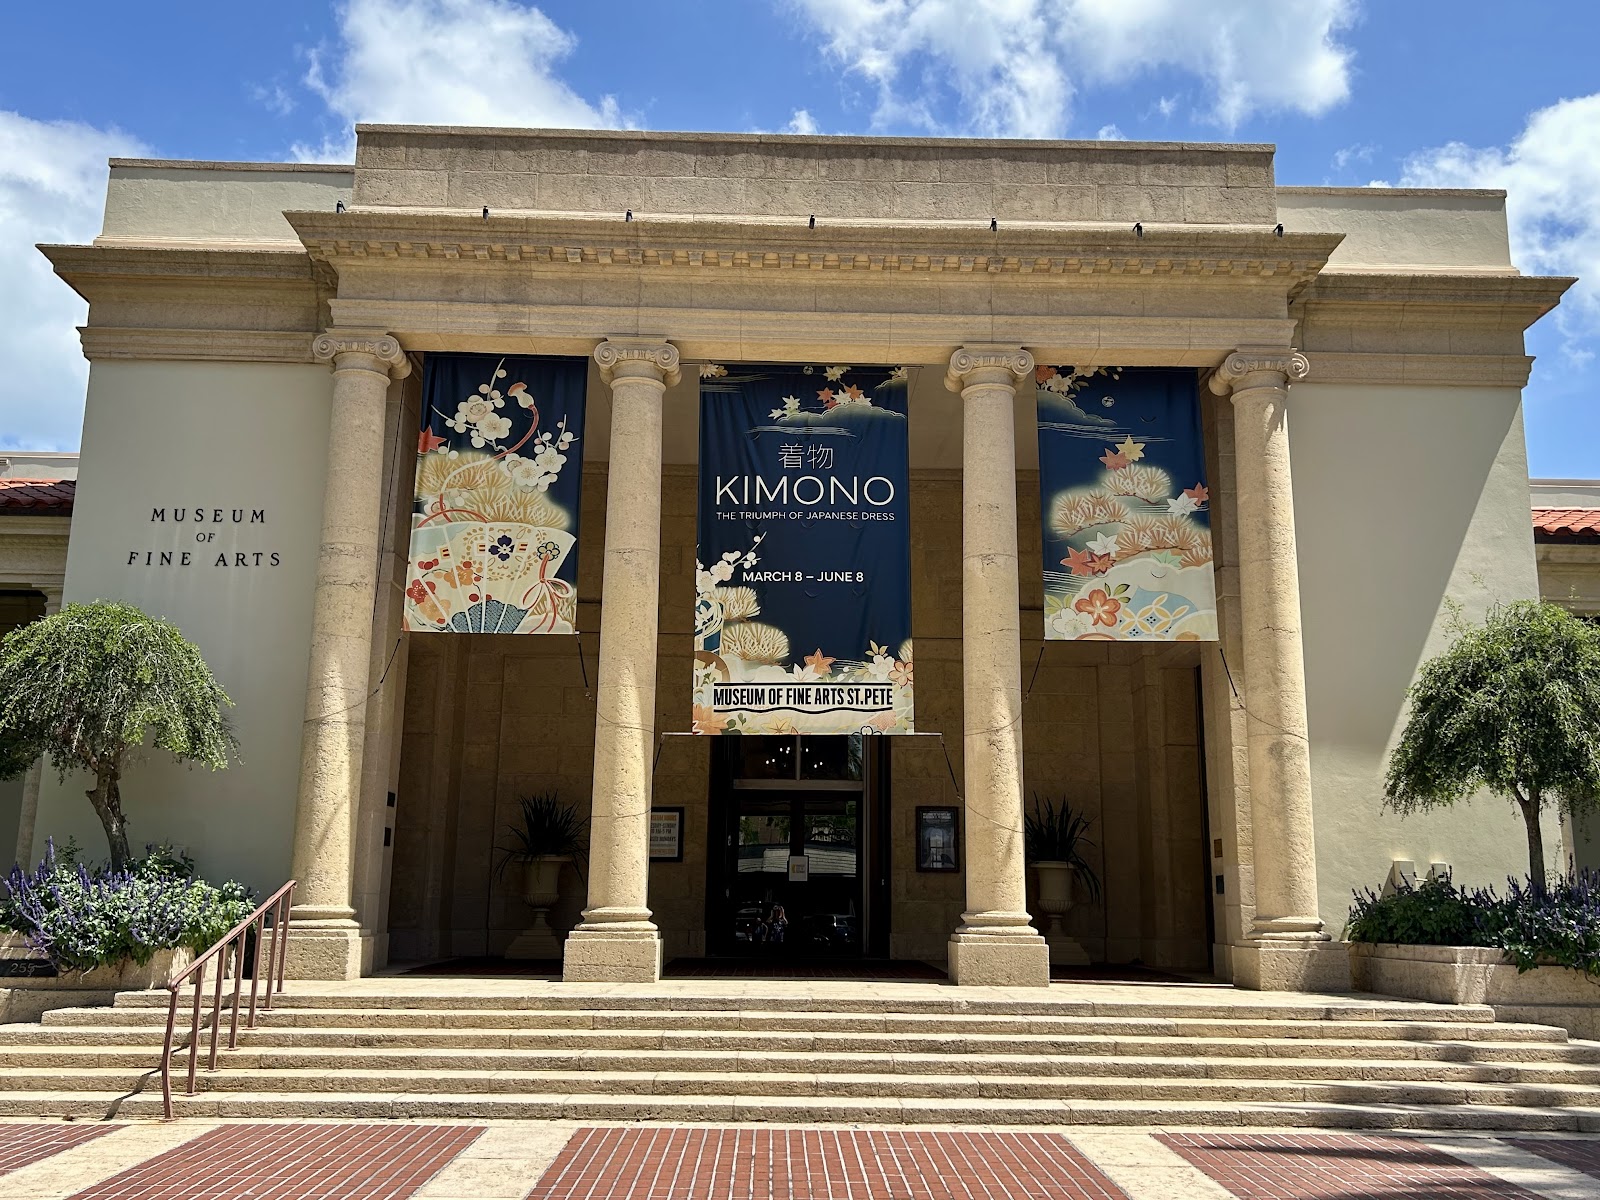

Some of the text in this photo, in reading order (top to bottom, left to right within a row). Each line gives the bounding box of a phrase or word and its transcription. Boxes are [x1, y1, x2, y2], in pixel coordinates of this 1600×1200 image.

[778, 443, 834, 470] 着物
[716, 475, 895, 506] KIMONO
[151, 508, 265, 523] MUSEUM
[716, 511, 895, 521] THE TRIUMPH OF JAPANESE DRESS
[196, 532, 216, 543] OF
[127, 551, 280, 567] FINE ARTS
[742, 571, 792, 582] MARCH
[794, 571, 803, 582] 8
[817, 571, 853, 582] JUNE
[855, 571, 864, 582] 8
[713, 688, 765, 706] MUSEUM
[768, 688, 783, 705] OF
[786, 688, 812, 705] FINE
[814, 687, 844, 705] ARTS
[10, 962, 35, 973] 255
